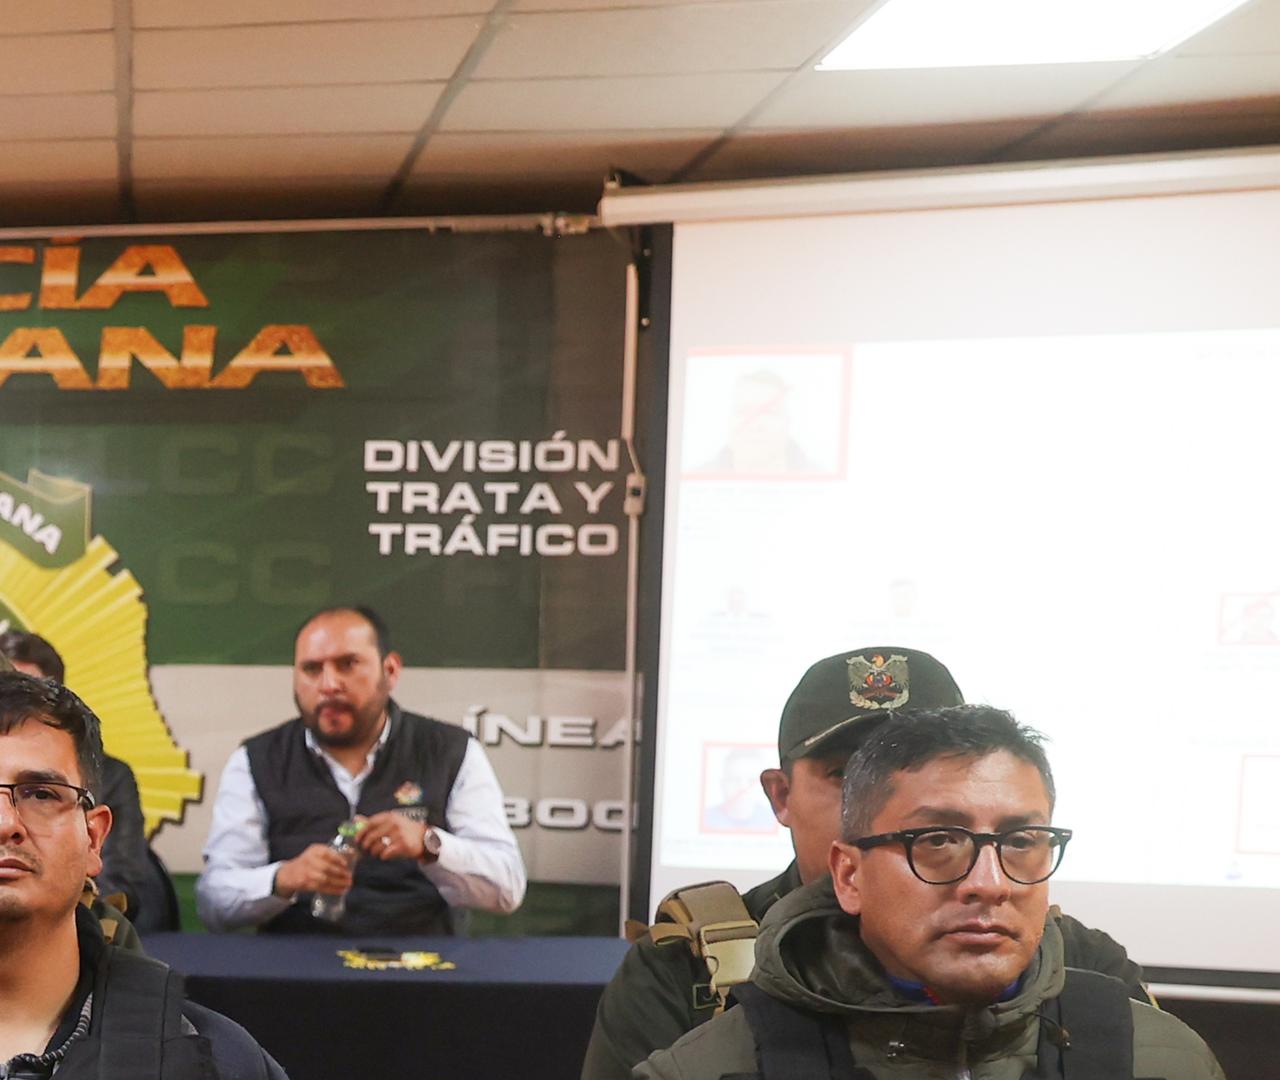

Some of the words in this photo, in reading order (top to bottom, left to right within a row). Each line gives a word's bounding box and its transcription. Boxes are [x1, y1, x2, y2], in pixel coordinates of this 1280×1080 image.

[364, 430, 619, 472] DIVISIÓN
[366, 482, 561, 513] TRATA
[575, 481, 614, 513] Y
[368, 514, 619, 555] TRÁFICO
